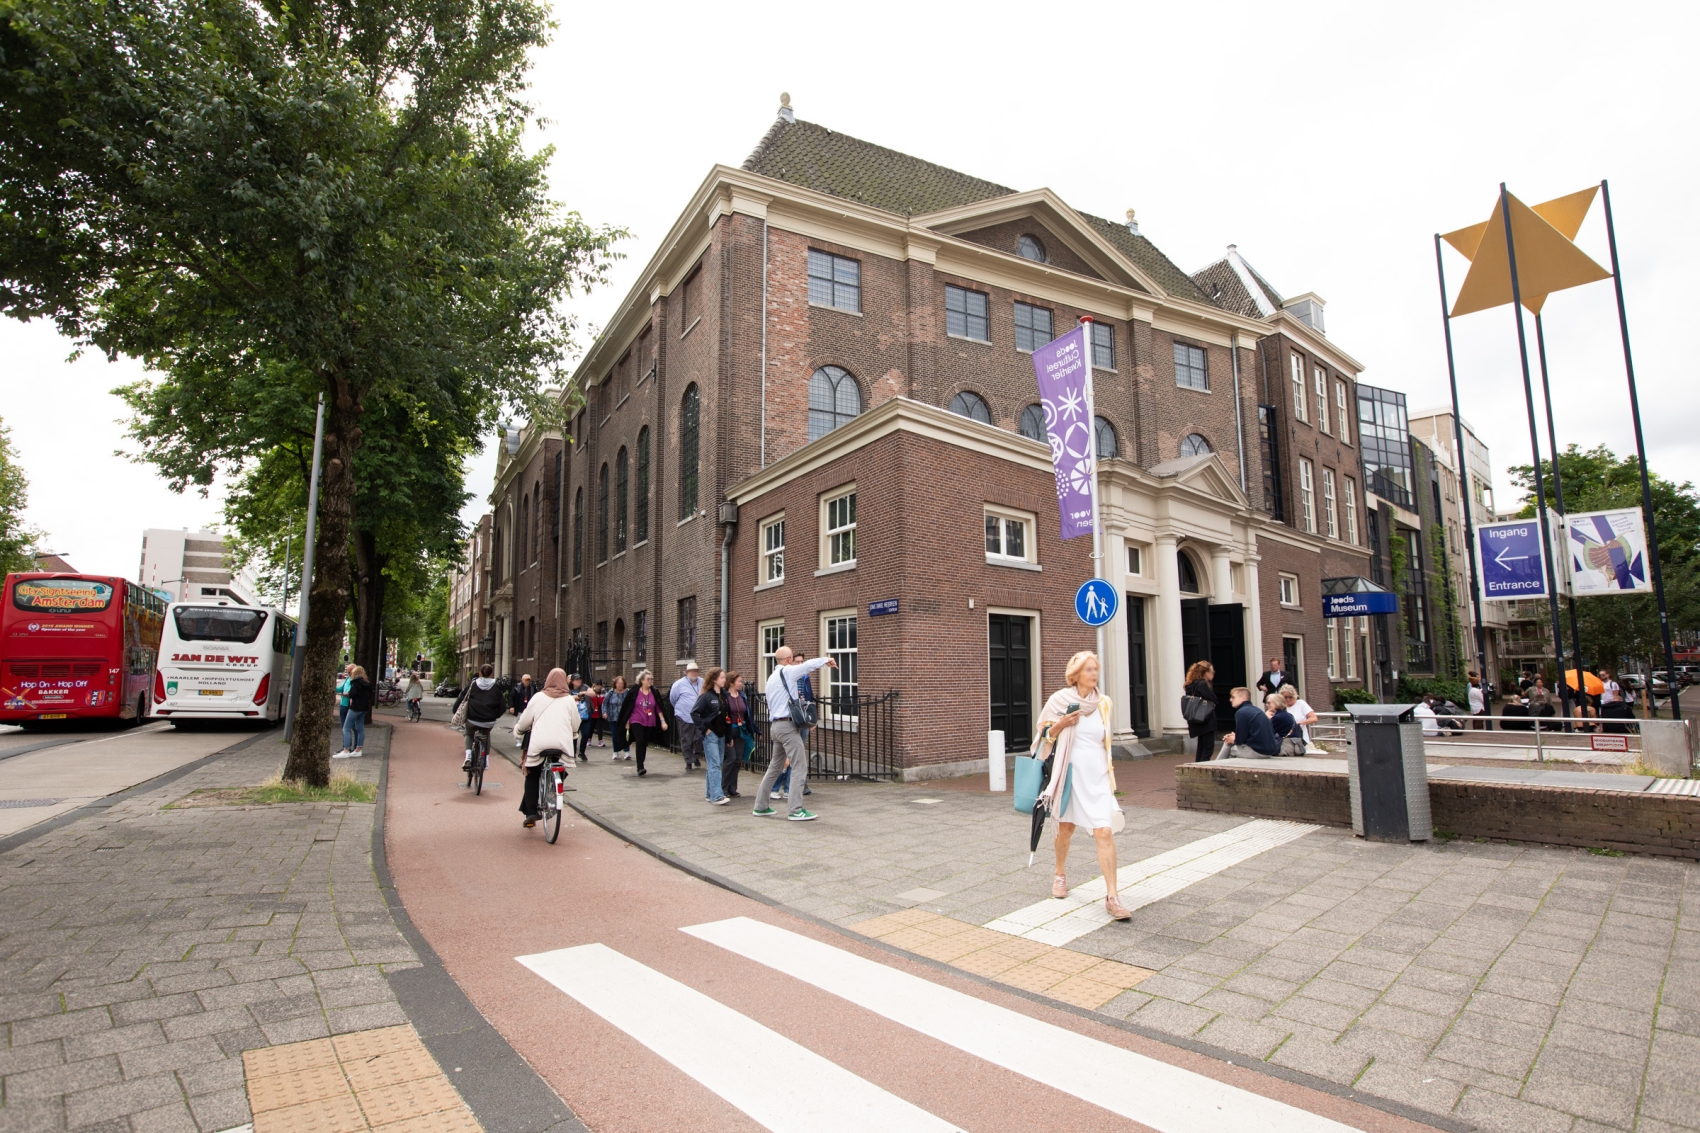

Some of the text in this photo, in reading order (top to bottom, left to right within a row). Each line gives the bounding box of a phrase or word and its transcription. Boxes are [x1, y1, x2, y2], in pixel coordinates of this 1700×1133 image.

[1489, 528, 1528, 539] Ingang
[1489, 581, 1540, 591] Entrance
[31, 595, 105, 609] Amsterdam
[1330, 595, 1355, 604] Joods
[1330, 604, 1368, 613] Museum
[171, 653, 259, 664] JAN DE WIT
